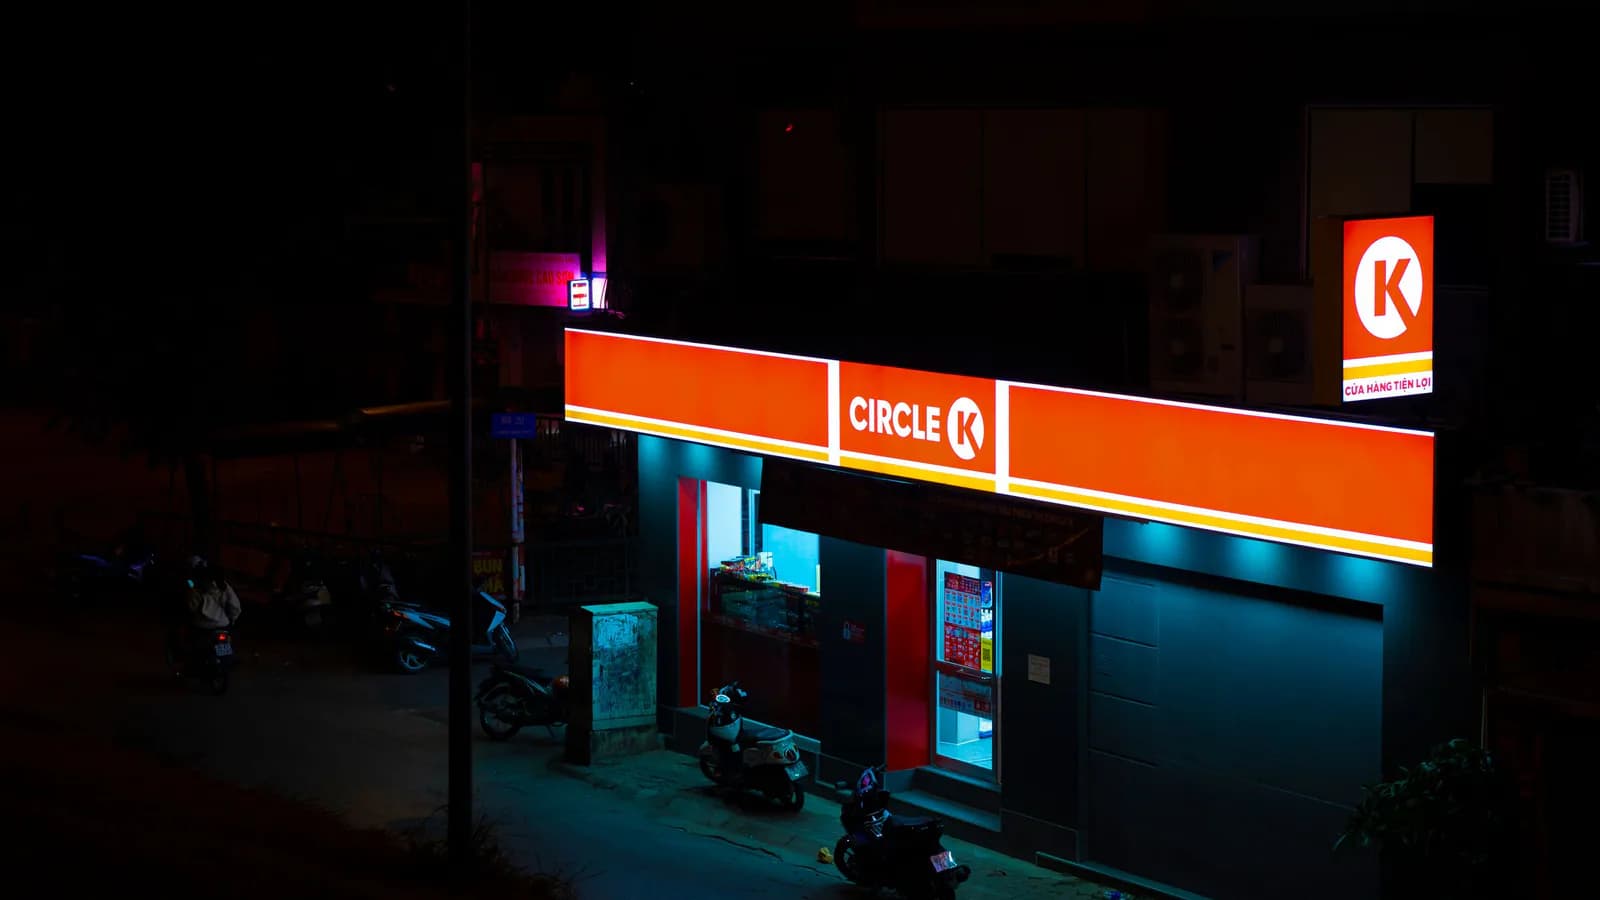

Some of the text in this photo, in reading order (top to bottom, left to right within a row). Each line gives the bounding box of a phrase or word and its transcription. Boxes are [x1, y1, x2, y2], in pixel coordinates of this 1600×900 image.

[1366, 381, 1393, 394] HÀNG
[1393, 377, 1414, 392] TIỆN
[849, 396, 941, 442] CIRCLE
